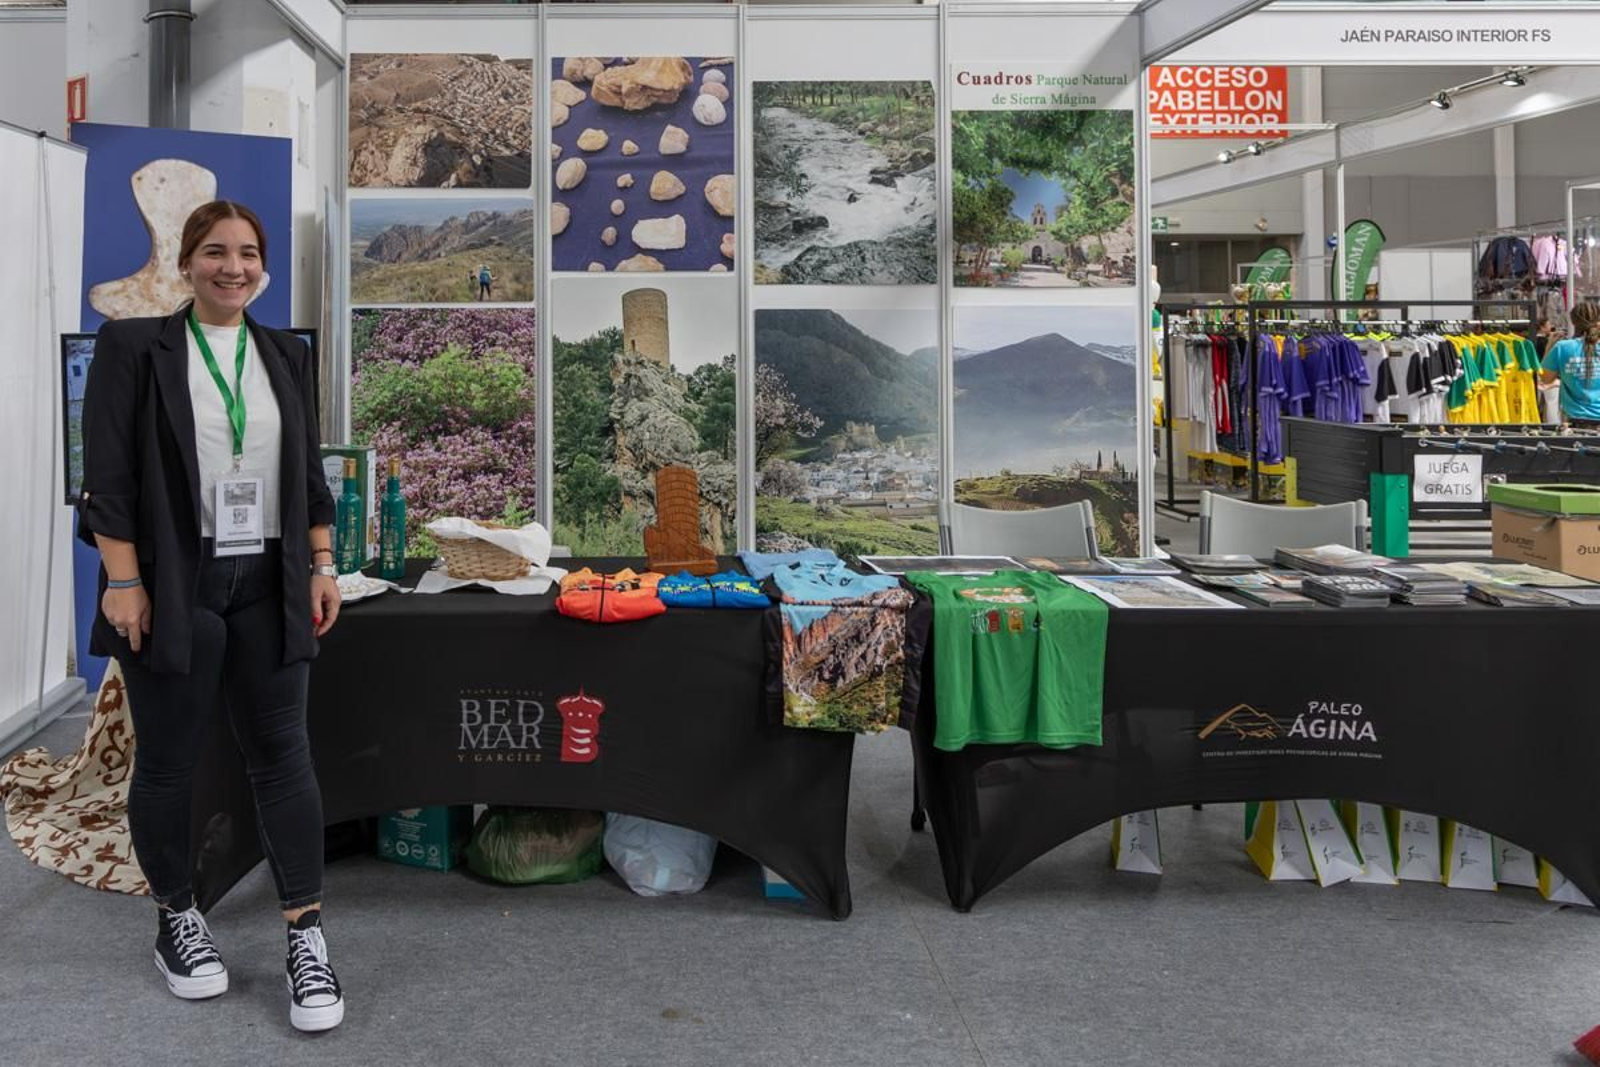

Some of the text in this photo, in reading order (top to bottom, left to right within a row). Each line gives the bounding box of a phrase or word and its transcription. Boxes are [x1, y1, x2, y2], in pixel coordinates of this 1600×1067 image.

[1341, 26, 1551, 43] JAÉN PARAISO INTERIOR FS
[956, 71, 1128, 89] Cuadros Parque Natural
[1156, 66, 1269, 88] ACCESO
[991, 93, 1007, 105] de
[1010, 93, 1047, 105] Sierra
[1148, 90, 1283, 111] PABELLON
[1149, 112, 1281, 134] EXTERIOR
[1427, 461, 1470, 474] JUEGA
[1423, 483, 1473, 496] GRATIS
[459, 699, 545, 726] BED
[1307, 700, 1363, 716] PALEO
[458, 723, 543, 750] MAR
[1287, 713, 1378, 742] ÁGINA
